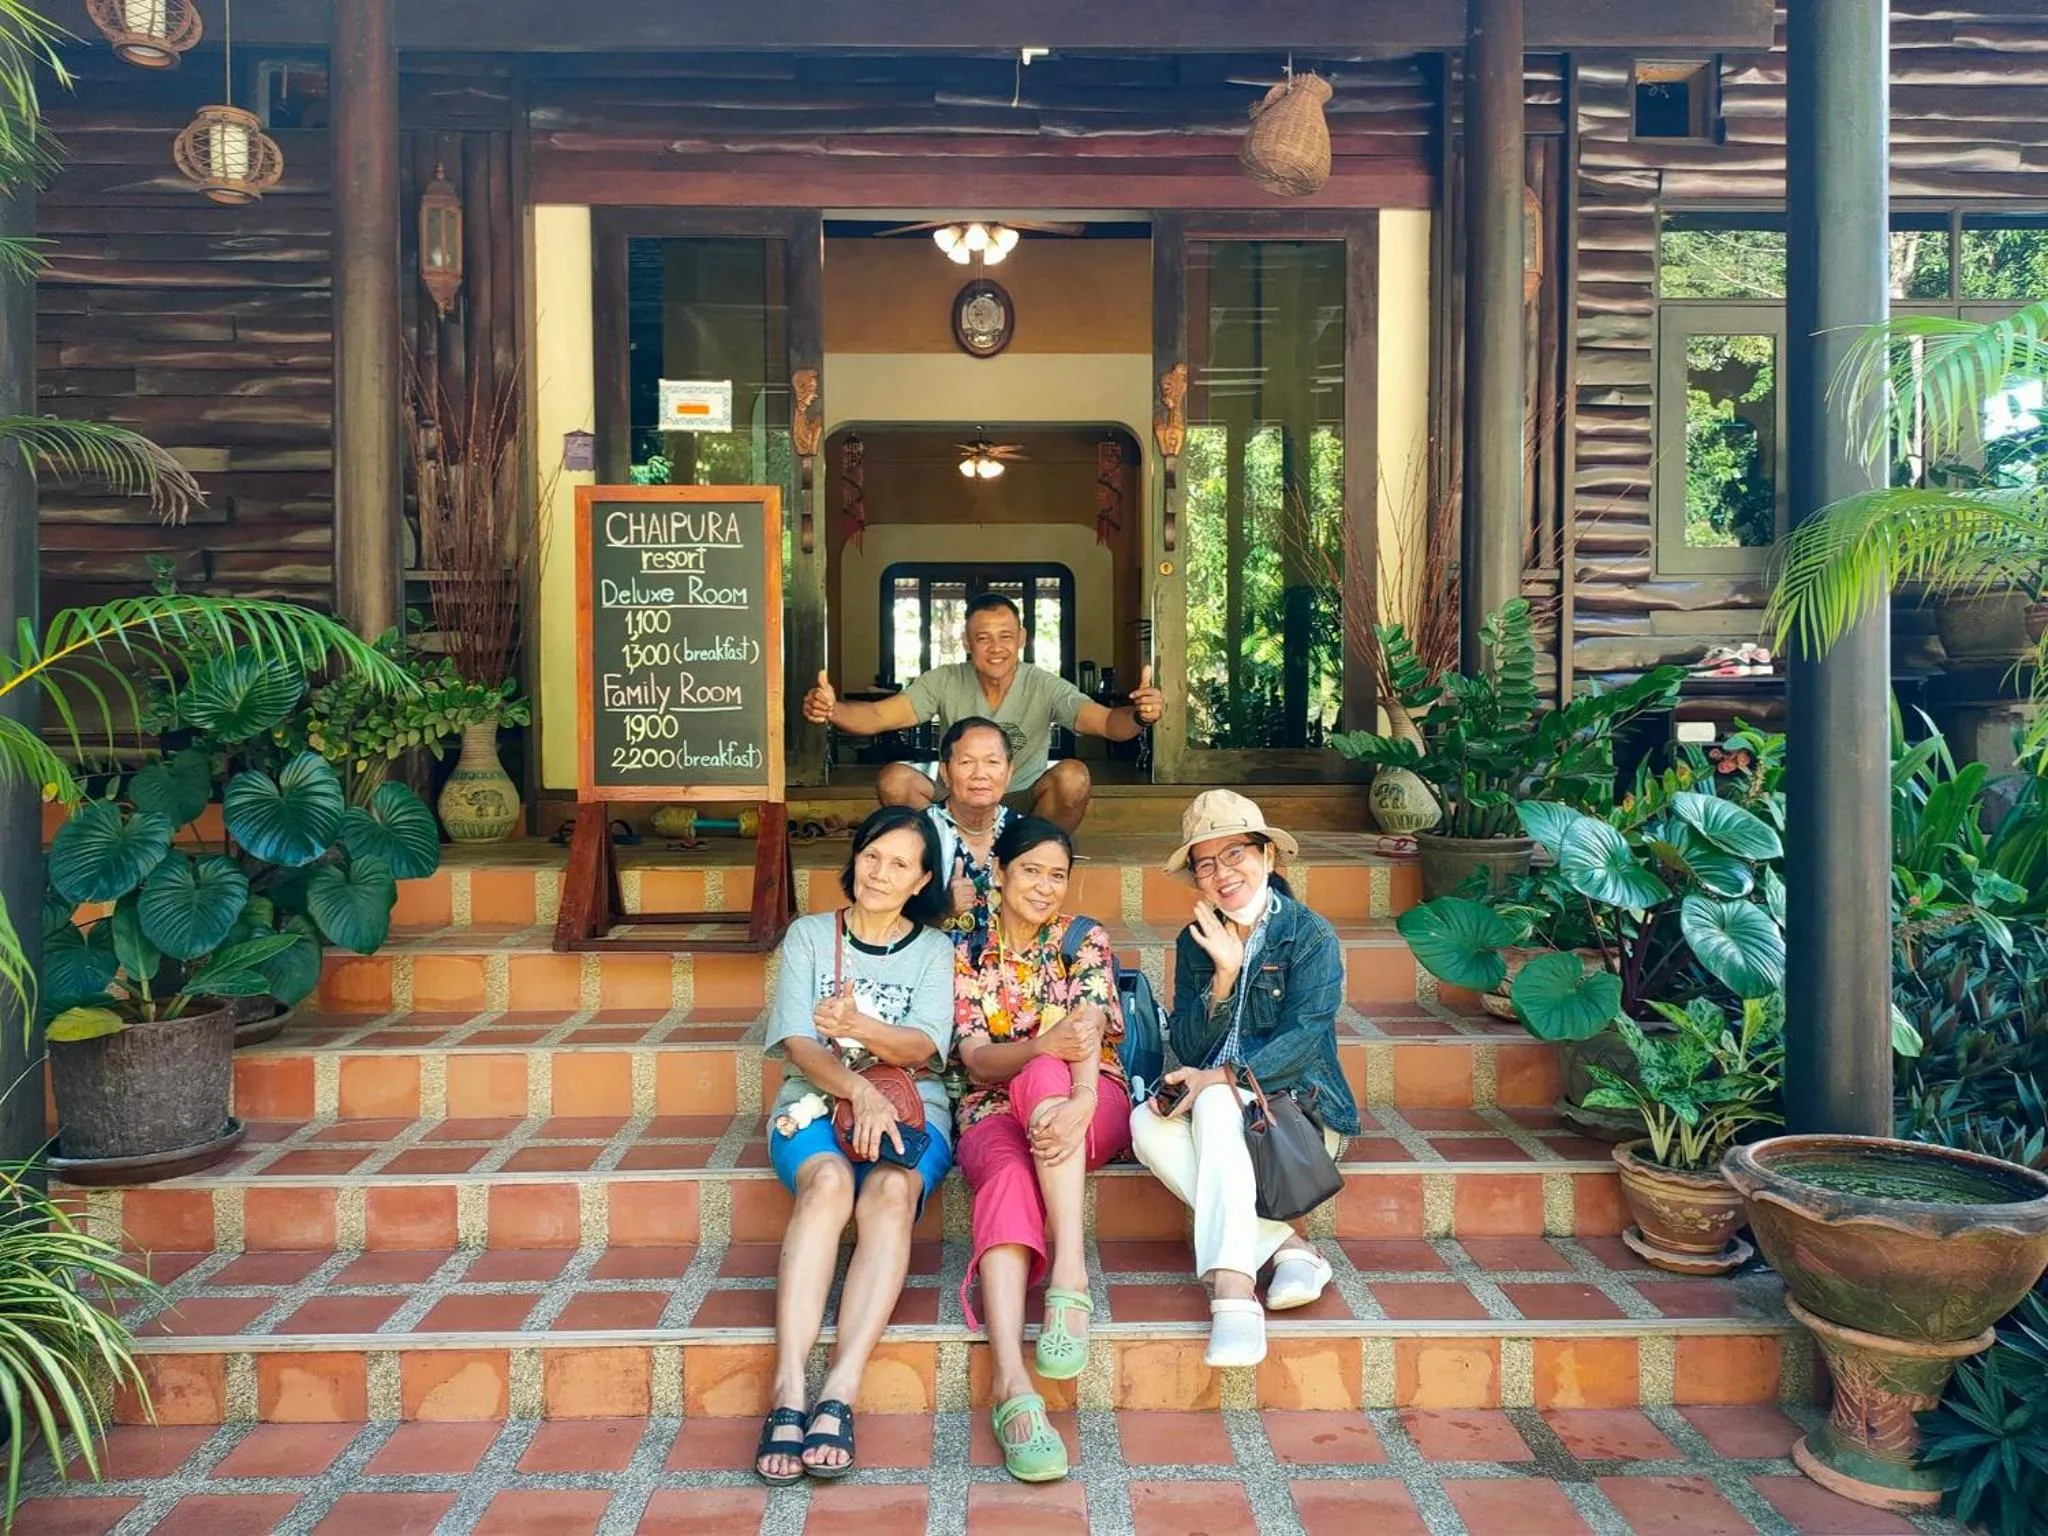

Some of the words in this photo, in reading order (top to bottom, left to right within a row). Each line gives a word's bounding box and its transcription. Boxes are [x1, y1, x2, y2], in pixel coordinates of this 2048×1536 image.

[606, 512, 740, 544] CHAIPURA
[642, 546, 706, 570] resort
[601, 577, 675, 607] Deluxe
[625, 610, 671, 640] 1,100
[673, 636, 759, 664] (breakfast)
[604, 672, 670, 714] Family
[624, 714, 678, 745] 1,900
